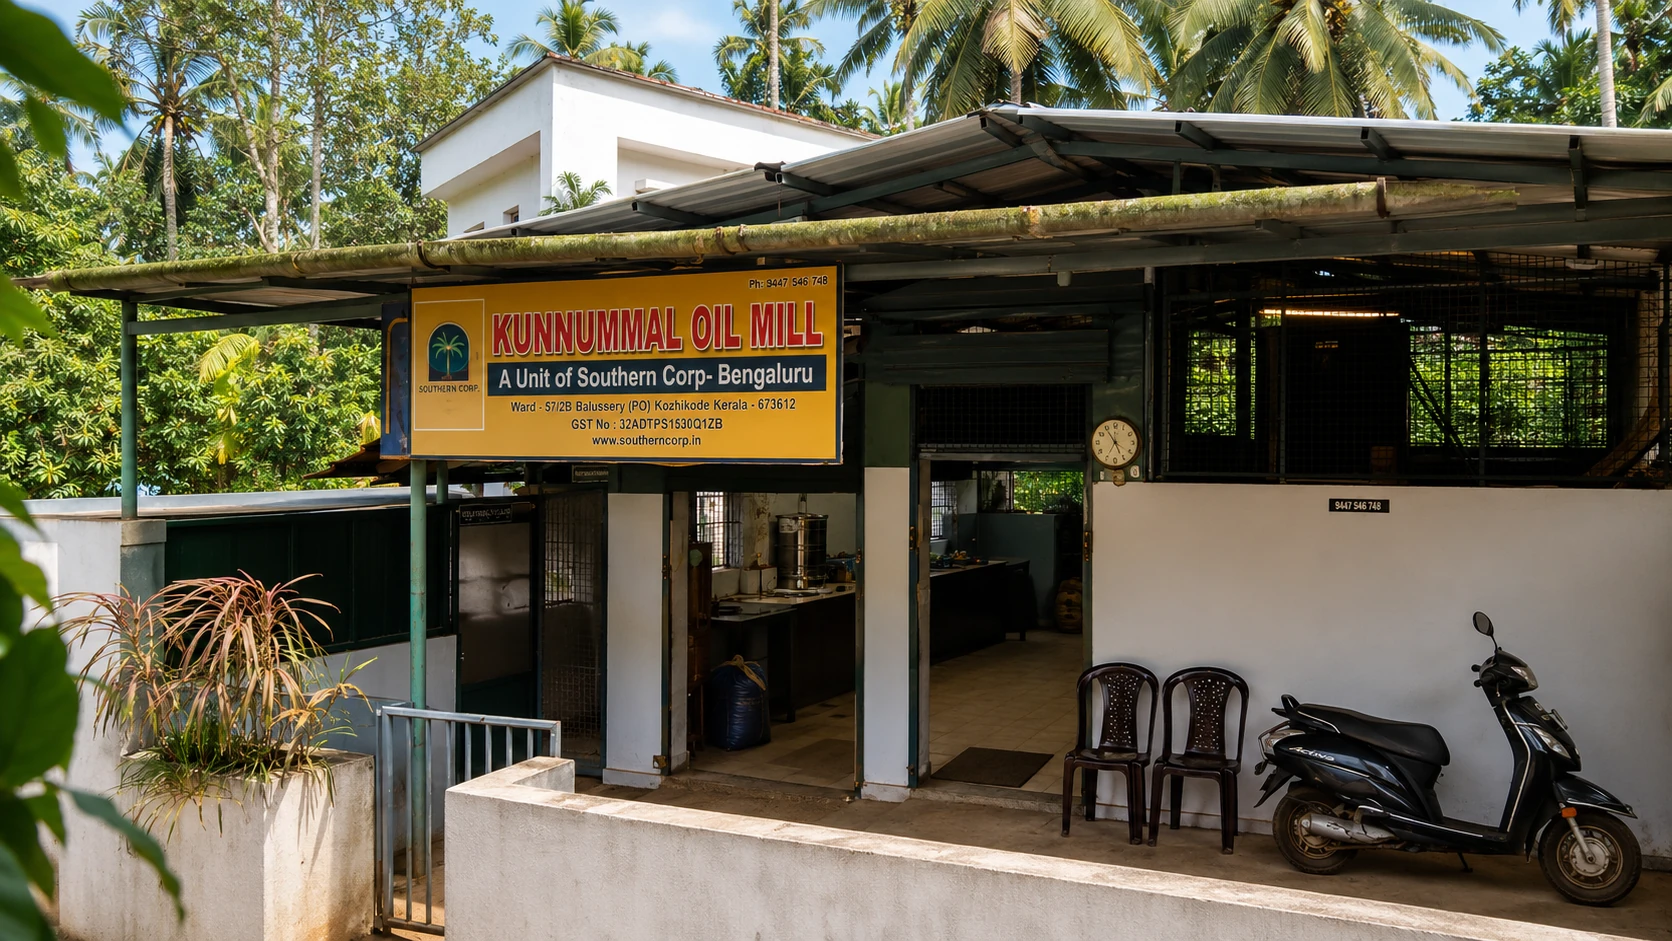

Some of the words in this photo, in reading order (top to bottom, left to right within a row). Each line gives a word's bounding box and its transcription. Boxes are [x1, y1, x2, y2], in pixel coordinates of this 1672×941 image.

[749, 279, 764, 289] Ph:
[812, 276, 828, 286] 748
[492, 307, 683, 356] KUNNUMMAL
[691, 303, 742, 350] OIL
[750, 301, 824, 348] MILL
[499, 368, 512, 388] A
[517, 367, 551, 388] Unit
[556, 366, 573, 387] of
[577, 365, 657, 388] Southern
[718, 362, 813, 390] Bengaluru
[419, 385, 457, 393] SOUTHERN
[511, 402, 536, 412] Ward
[576, 401, 625, 414] Balussery
[628, 400, 651, 414] (PO)
[654, 400, 710, 411] Kozhikode
[714, 399, 748, 410] Kerala
[758, 398, 796, 410] 673612
[571, 418, 593, 430] GST
[596, 418, 610, 430] No
[592, 434, 701, 448] www.southerncorp.in
[1335, 501, 1352, 510] 9447
[1368, 501, 1382, 511] 748
